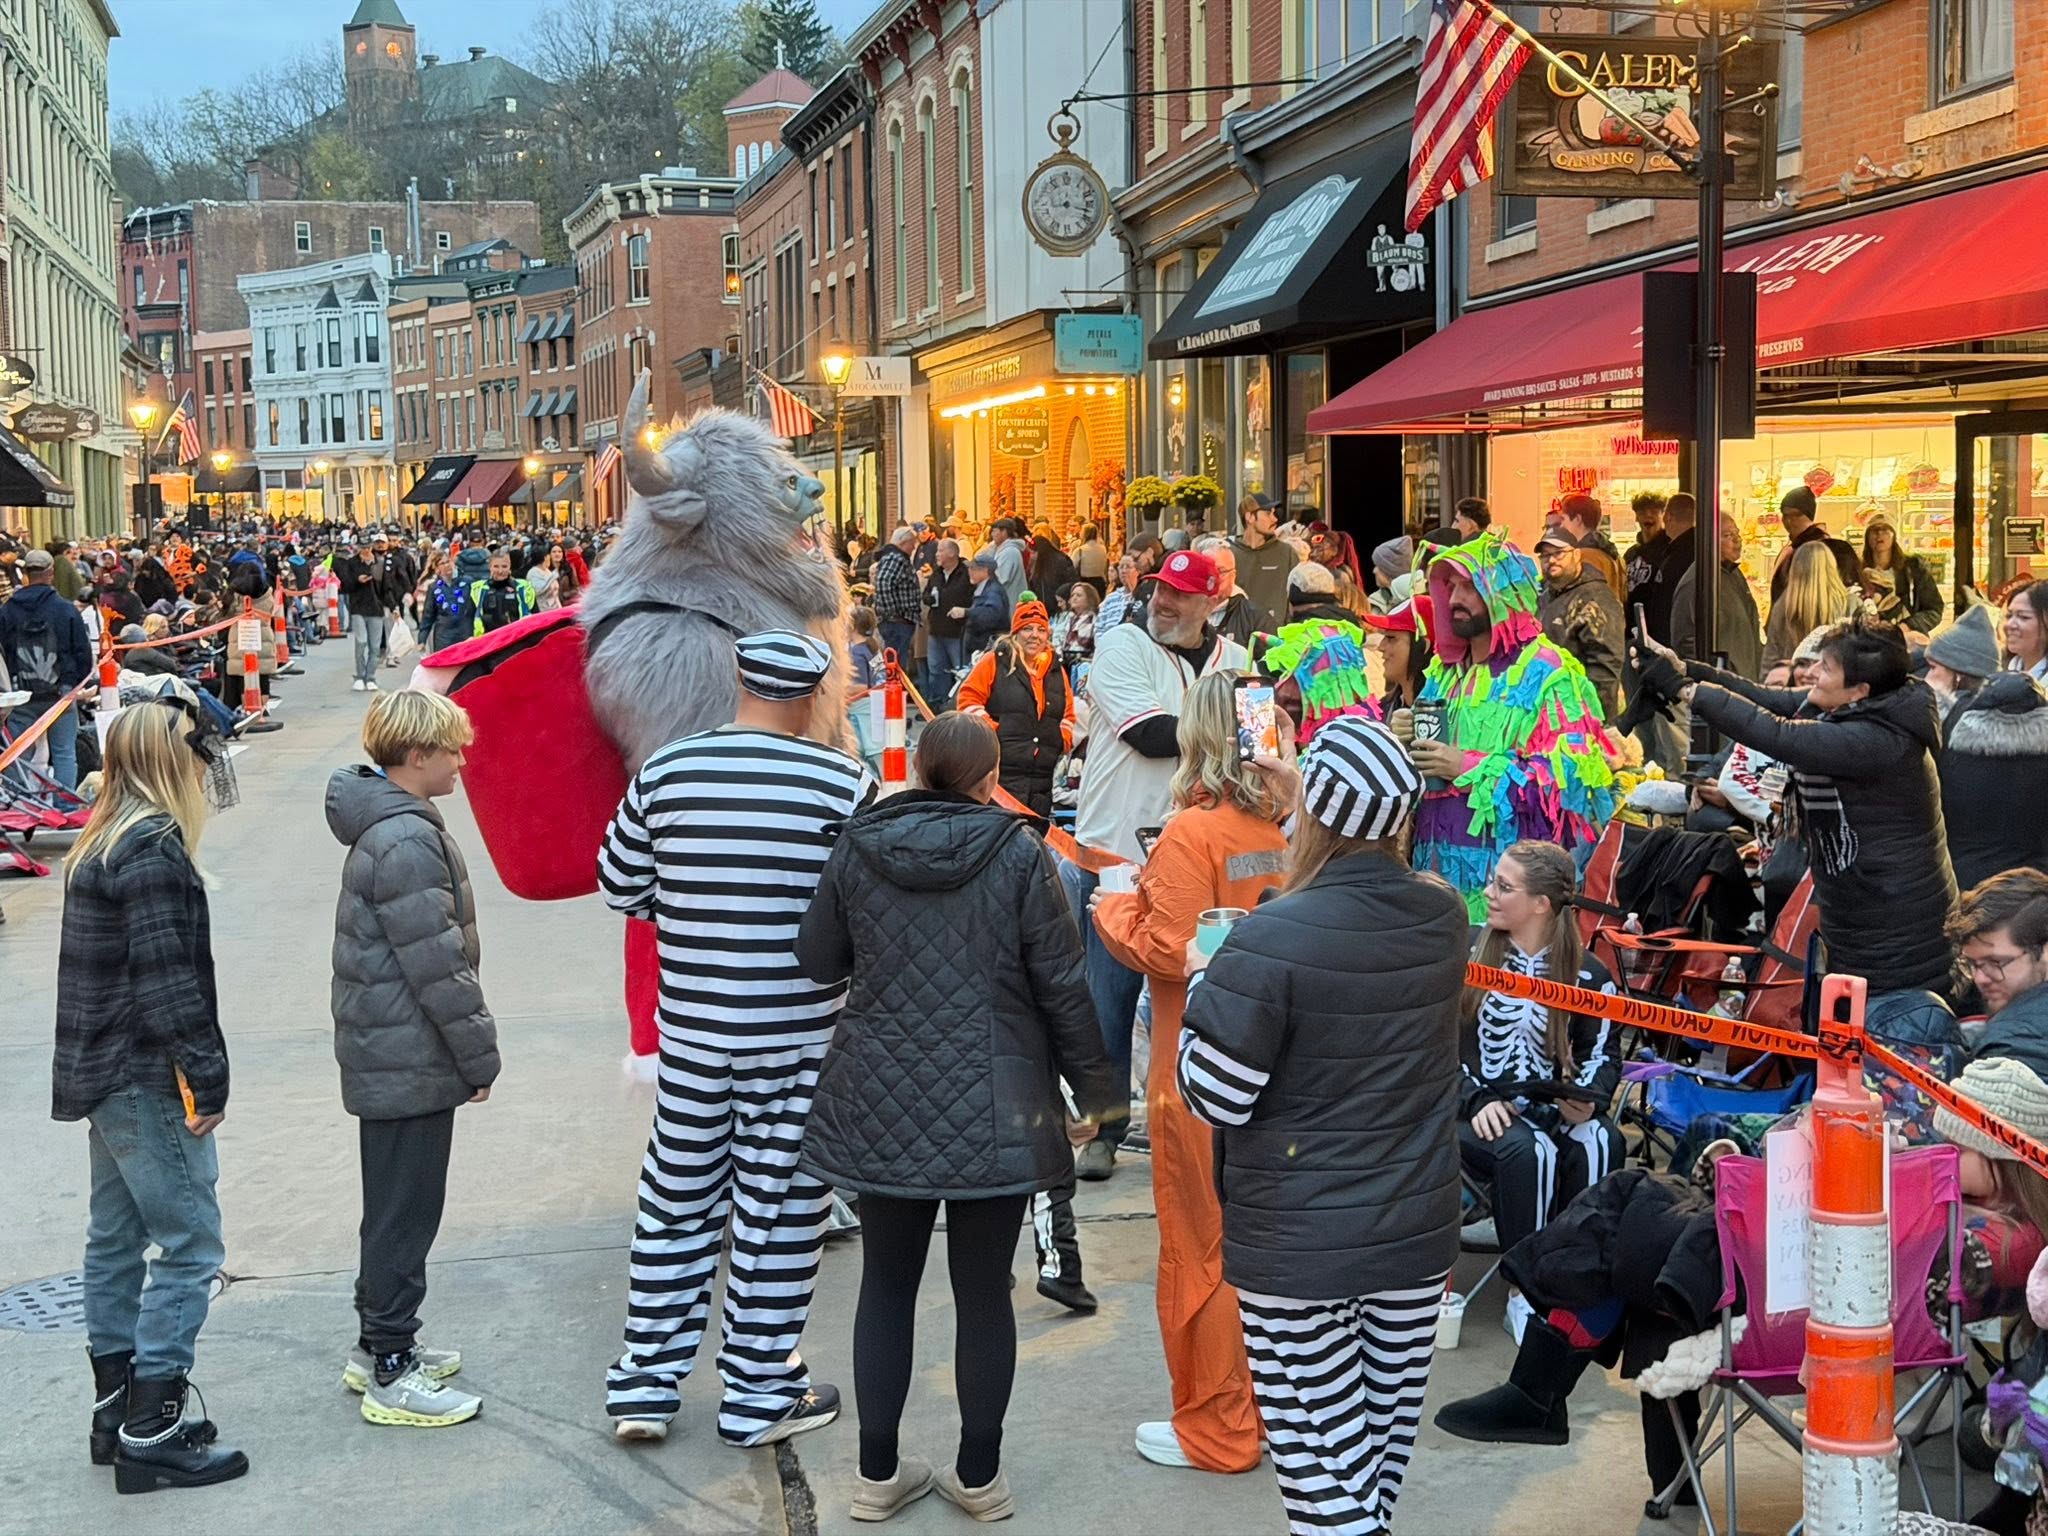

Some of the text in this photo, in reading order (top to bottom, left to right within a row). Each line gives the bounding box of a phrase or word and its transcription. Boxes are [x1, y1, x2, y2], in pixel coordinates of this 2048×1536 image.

[1547, 50, 1734, 97] GALEN
[1556, 152, 1635, 168] CANNING
[1372, 248, 1400, 262] BLAUM
[1758, 337, 1804, 358] PRESERVES
[1559, 376, 1580, 390] SALSAS
[1583, 372, 1597, 385] DIPS
[1600, 367, 1634, 383] MUSTARDS
[1611, 434, 1680, 455] WINNIN
